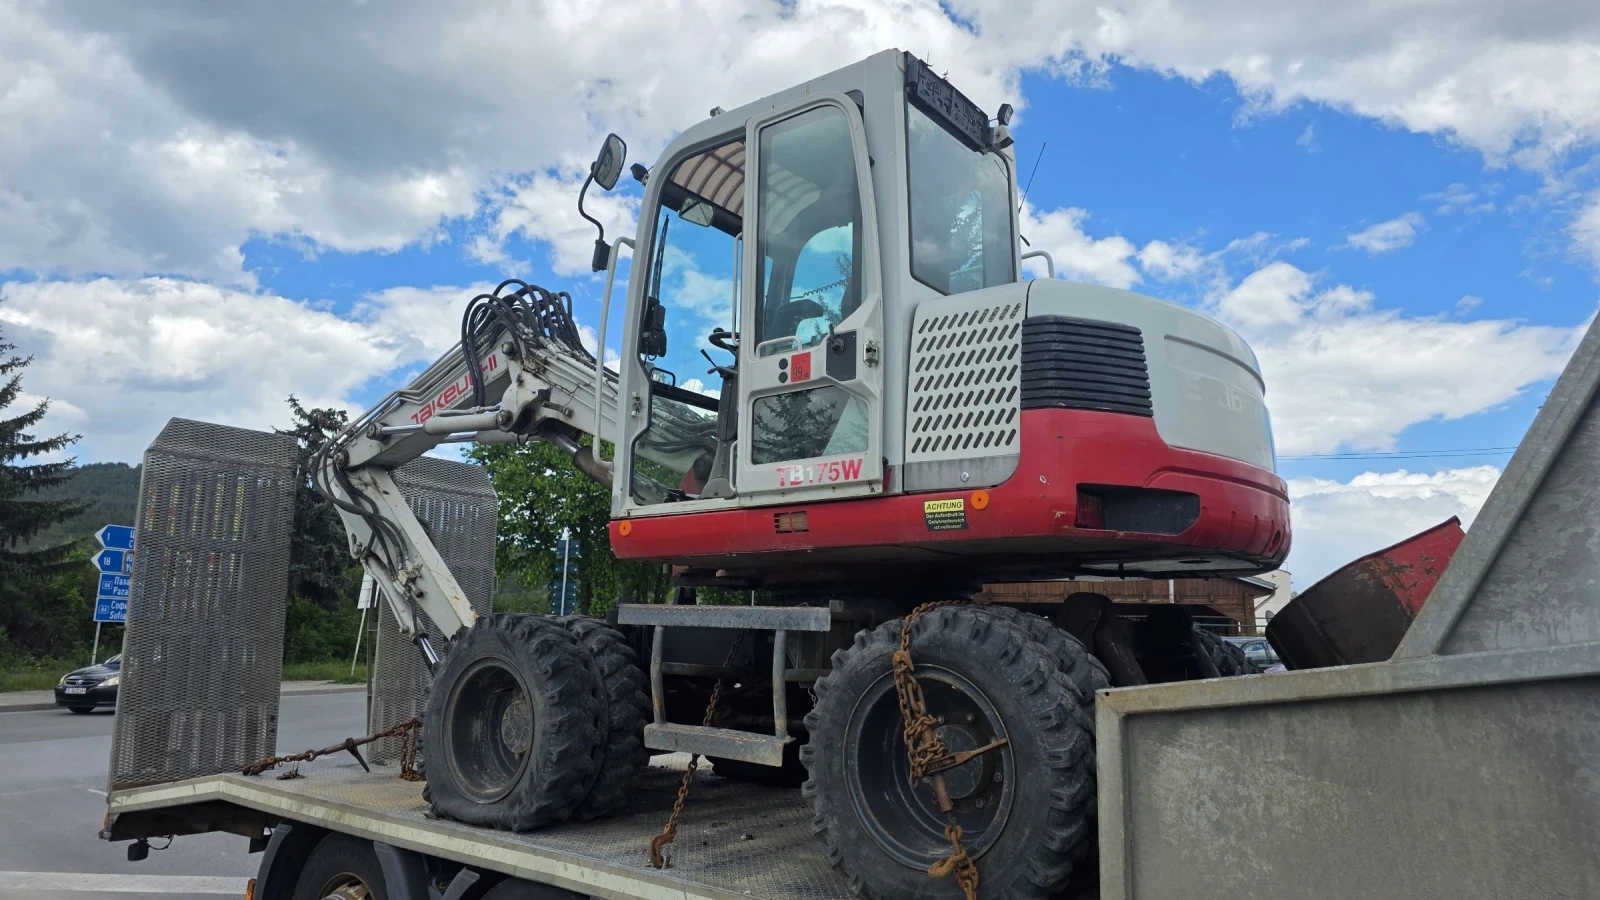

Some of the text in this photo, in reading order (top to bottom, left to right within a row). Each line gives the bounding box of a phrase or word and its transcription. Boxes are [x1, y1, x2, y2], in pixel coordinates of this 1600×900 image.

[776, 458, 863, 487] TB175W
[926, 502, 962, 510] ACHTUNG
[103, 556, 111, 566] 18
